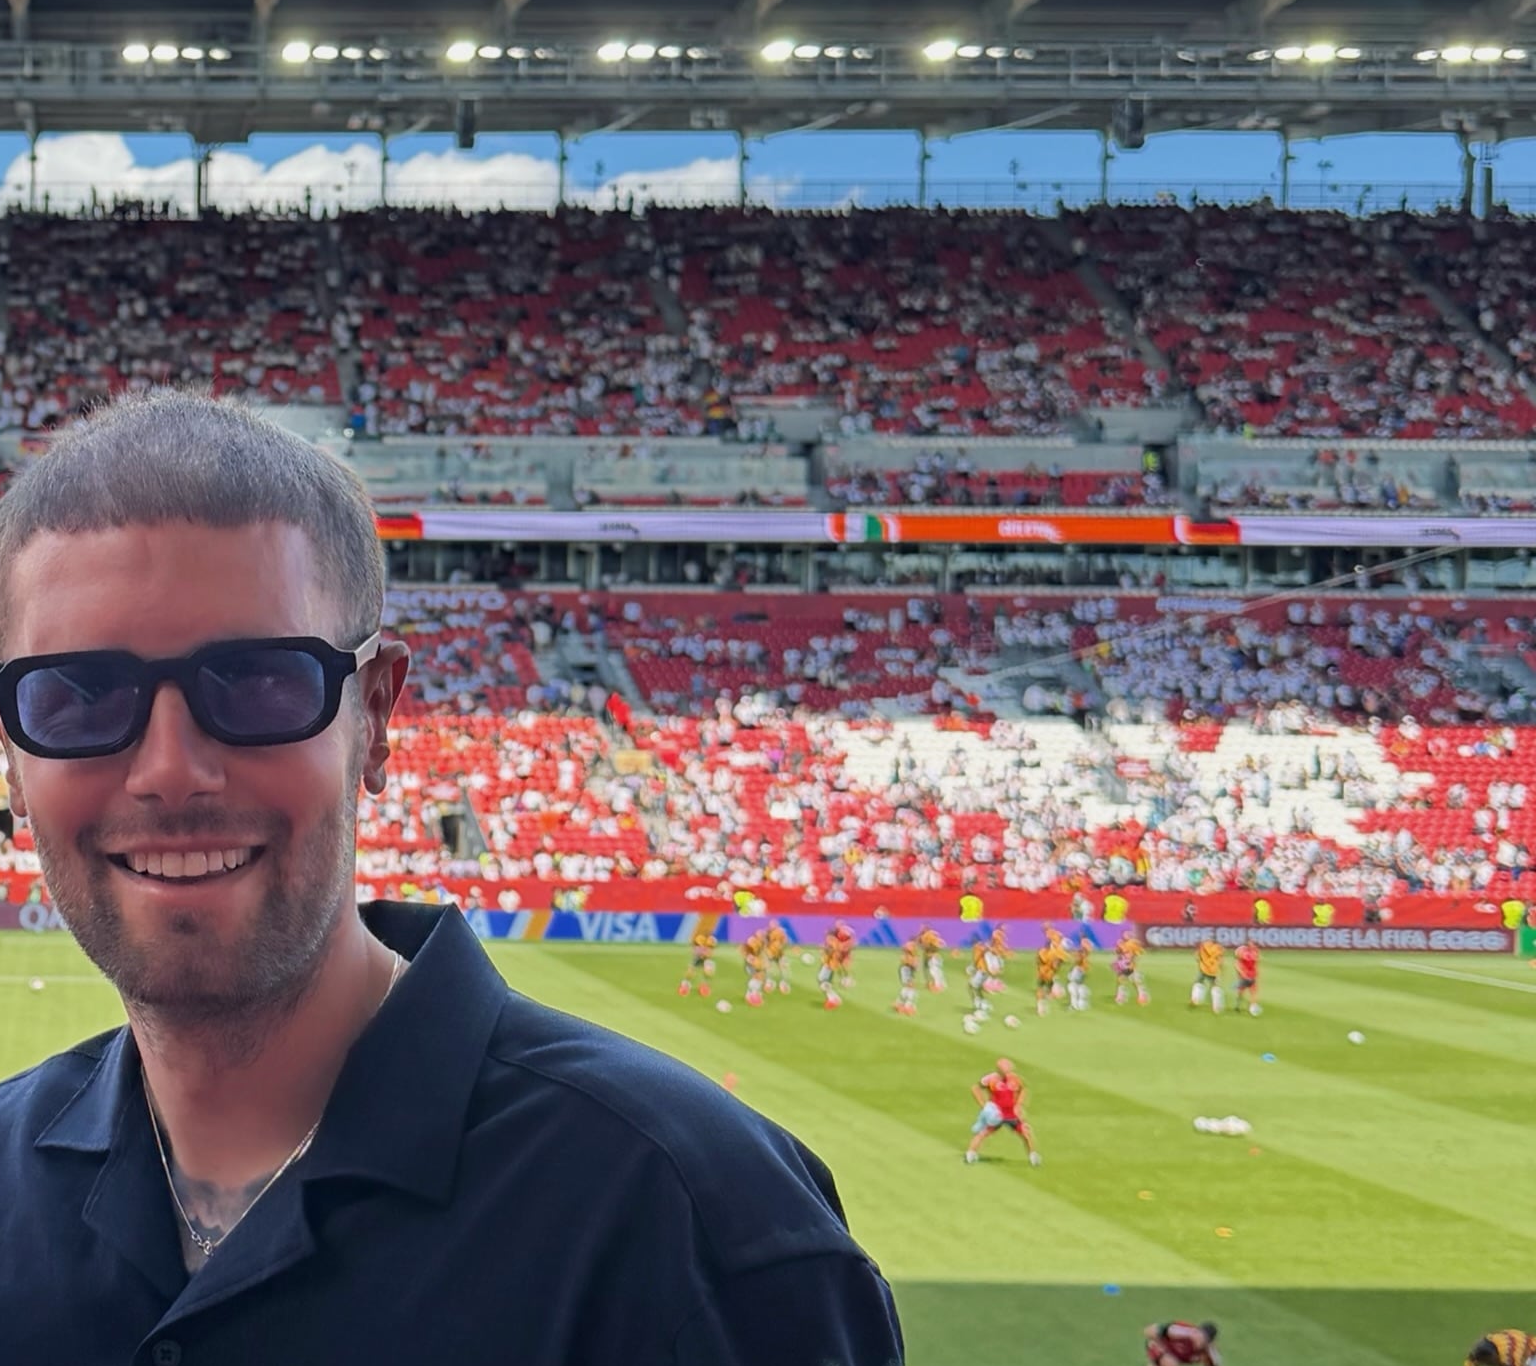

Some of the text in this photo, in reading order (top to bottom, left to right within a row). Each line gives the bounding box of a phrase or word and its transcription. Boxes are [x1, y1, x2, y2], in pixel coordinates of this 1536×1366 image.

[575, 911, 660, 941] VISA
[1145, 926, 1508, 951] COUPE DU MONDE DE LA FIFA 2026
